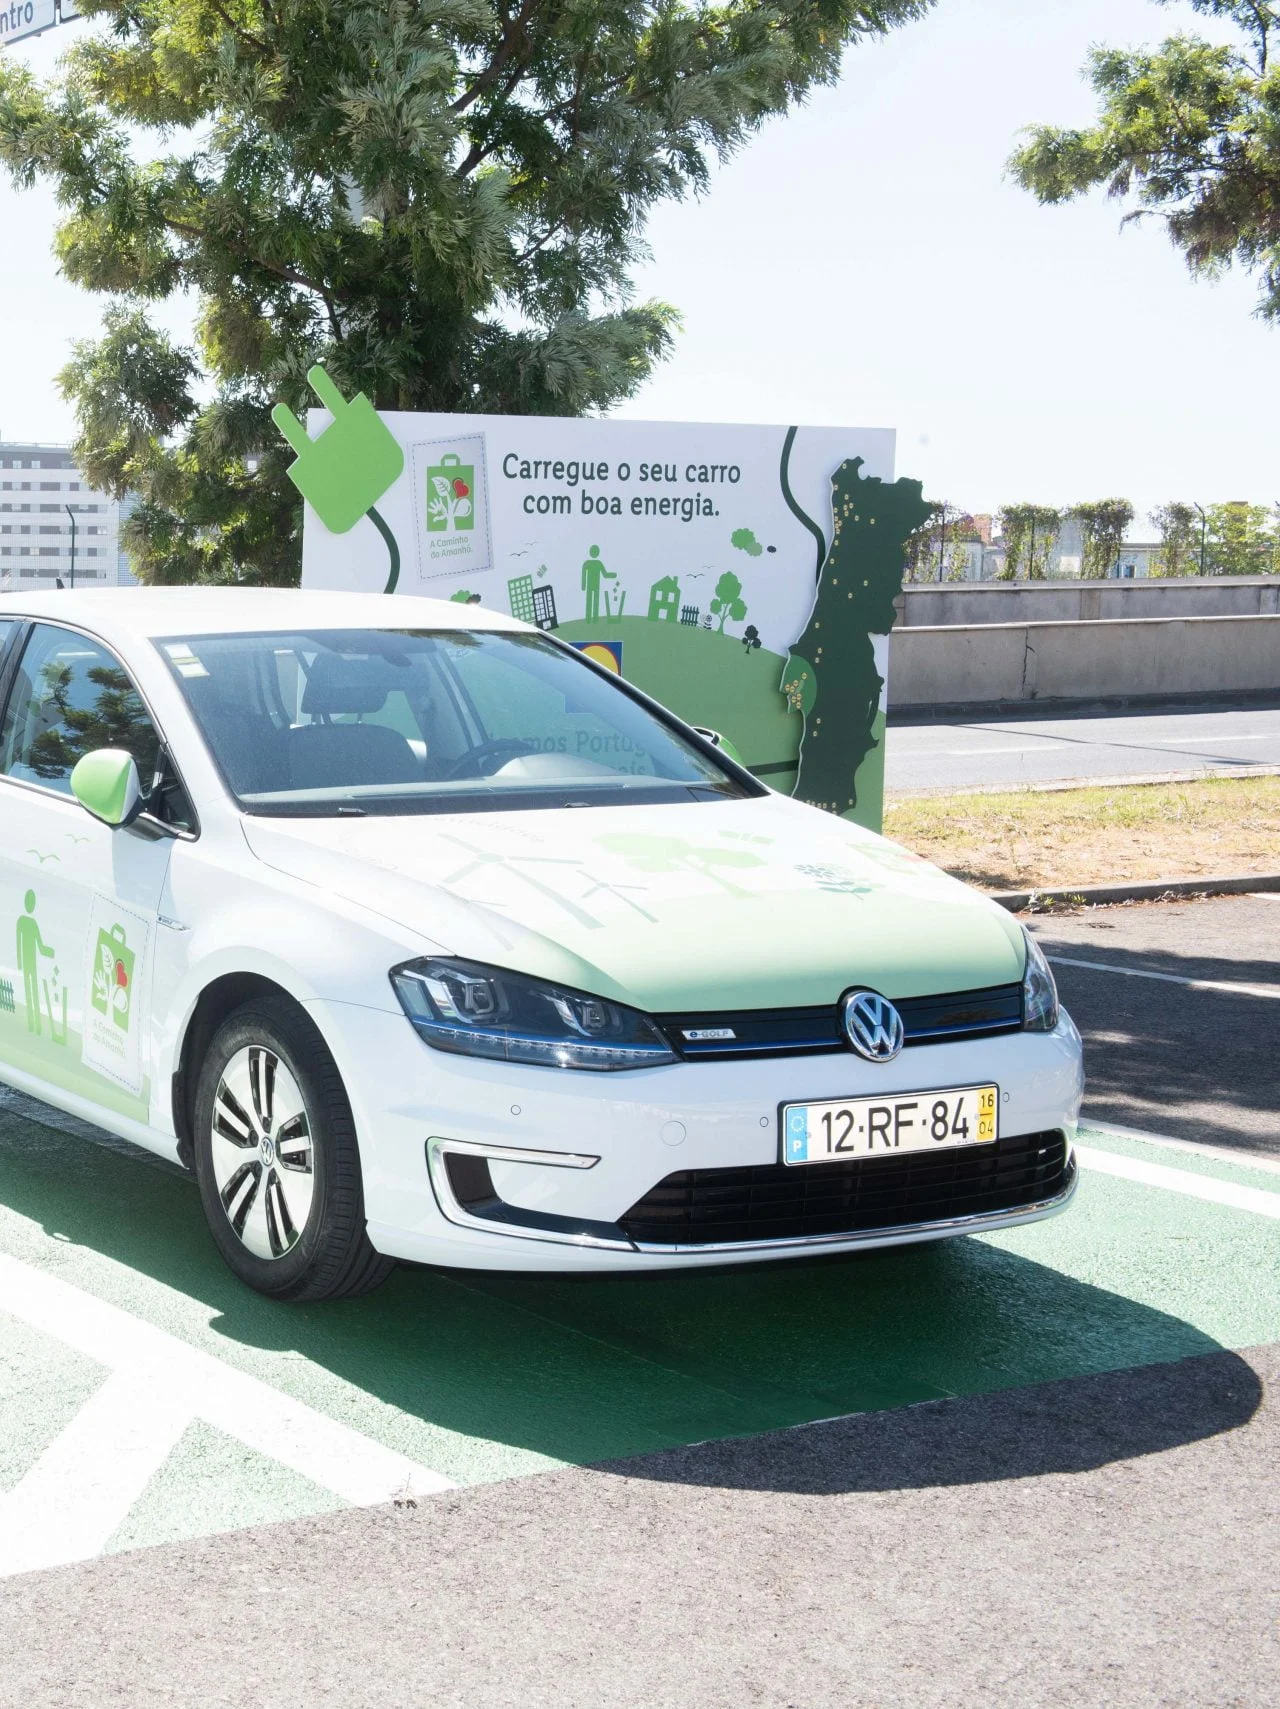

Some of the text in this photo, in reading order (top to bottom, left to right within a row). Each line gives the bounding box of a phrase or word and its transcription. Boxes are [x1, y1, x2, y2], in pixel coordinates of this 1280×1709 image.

[502, 453, 741, 487] Carregue o seu carro
[522, 489, 720, 523] com boa energia.
[430, 536, 469, 548] A Caminho
[980, 1093, 994, 1109] 16
[978, 1121, 993, 1135] 04
[792, 1139, 802, 1153] P
